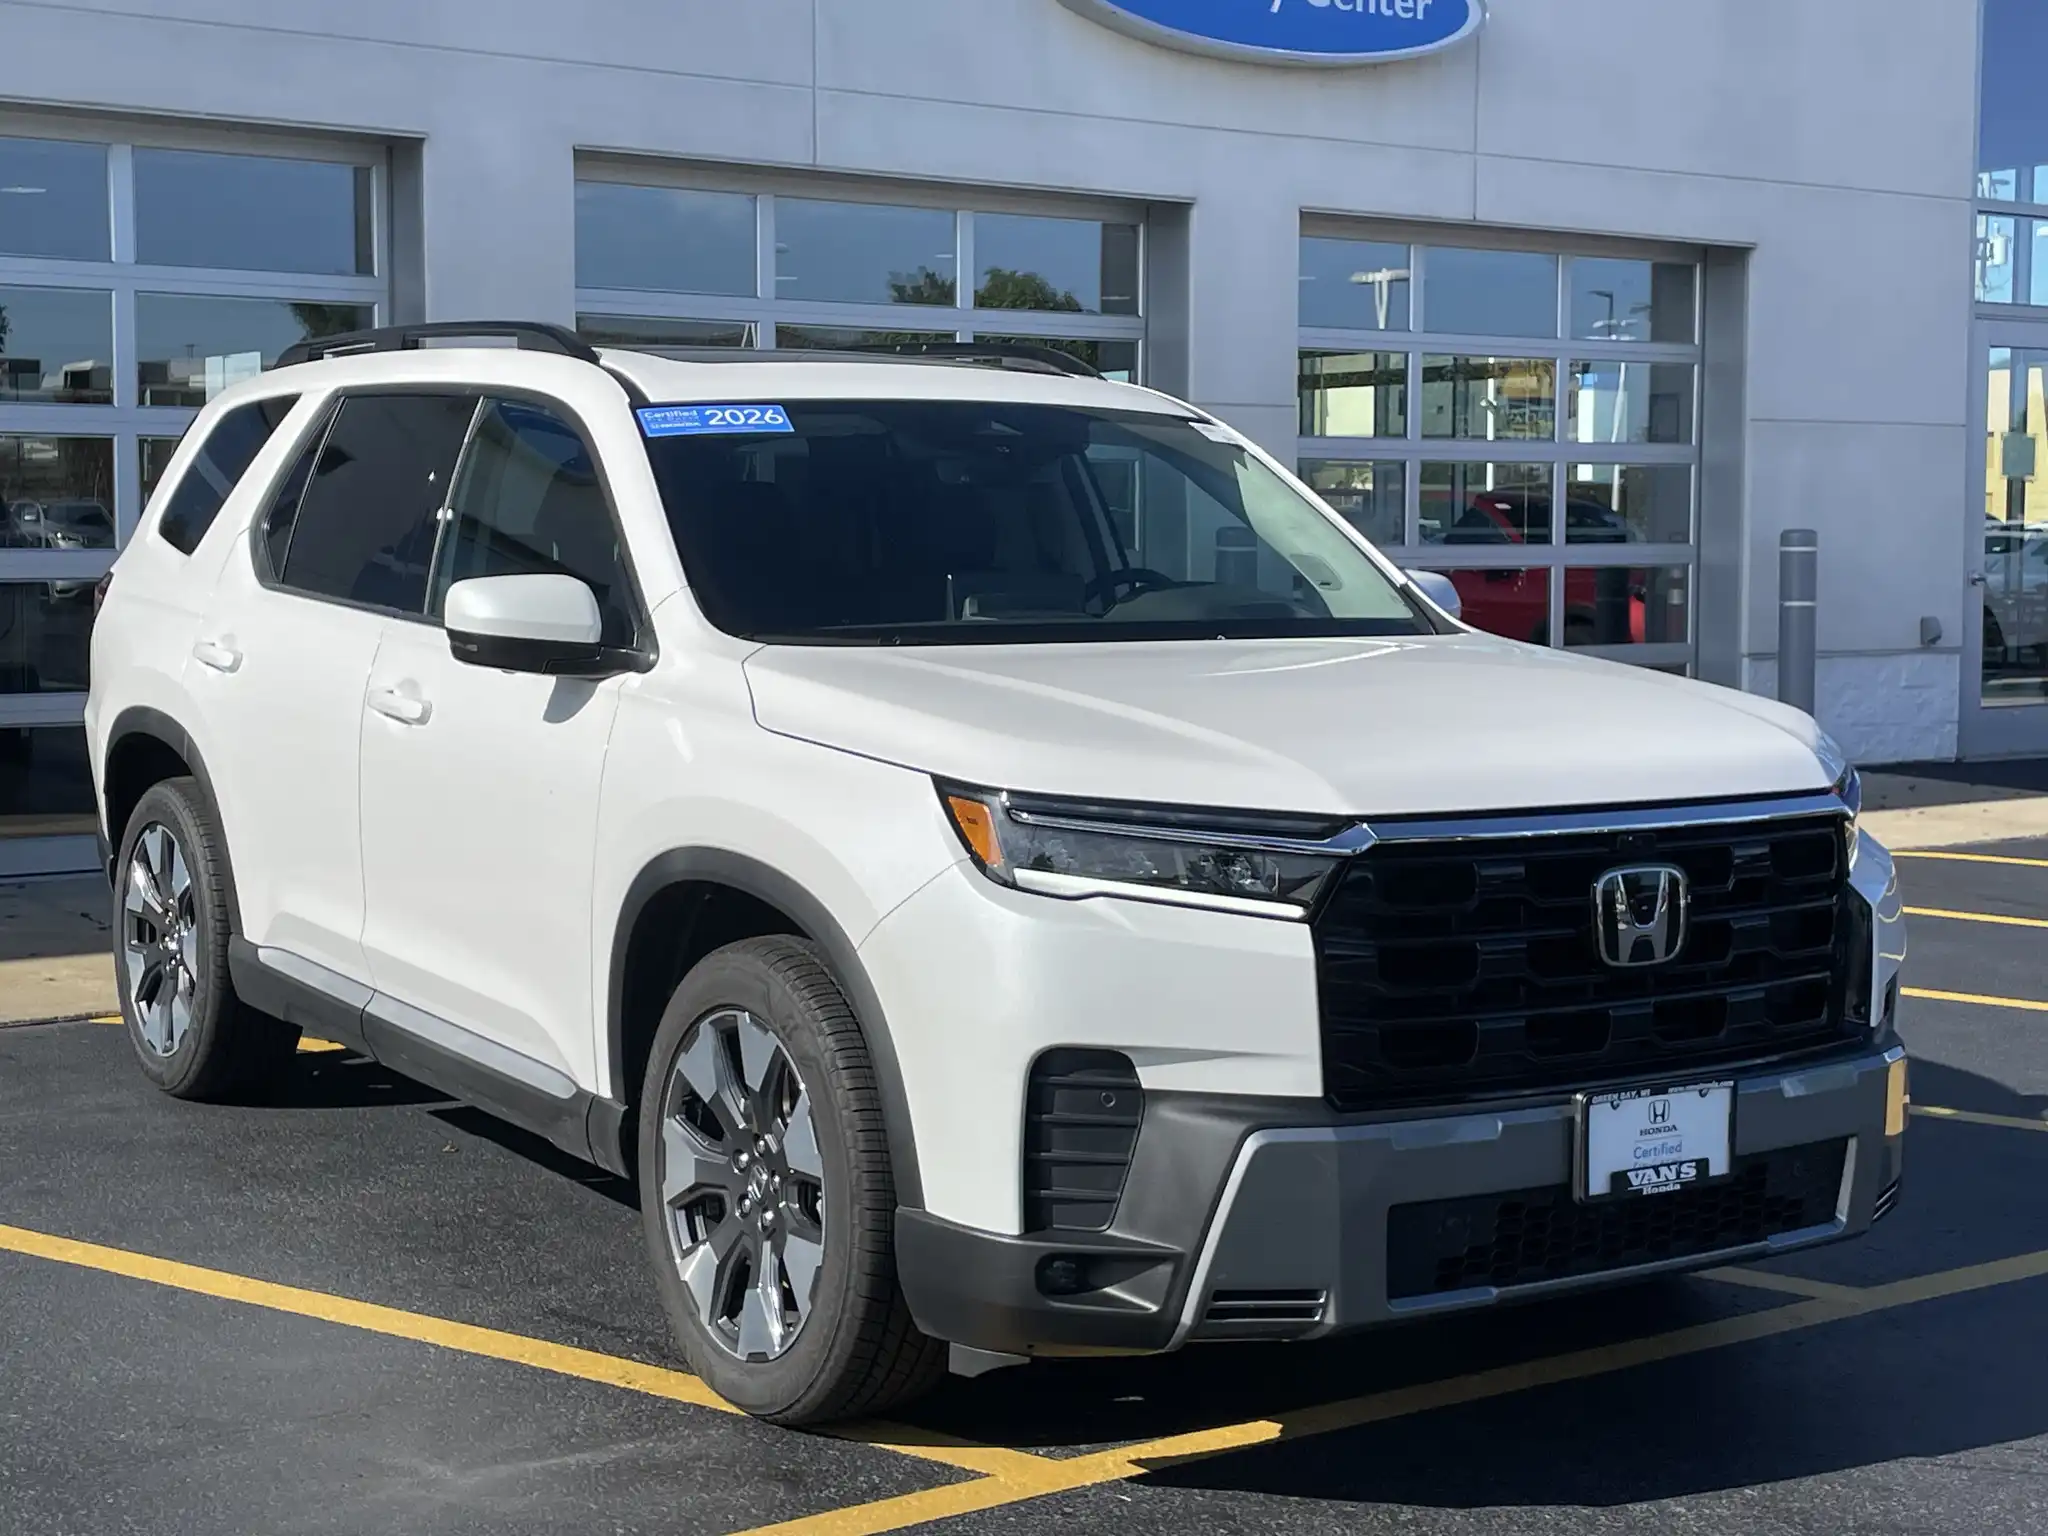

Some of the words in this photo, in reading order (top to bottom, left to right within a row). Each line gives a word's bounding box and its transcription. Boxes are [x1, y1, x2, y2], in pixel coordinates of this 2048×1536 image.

[1307, 0, 1432, 20] nter
[645, 410, 698, 419] Certified
[704, 408, 784, 425] 2026
[1639, 1124, 1678, 1137] HONDA
[1633, 1140, 1682, 1160] Certified
[1642, 1182, 1681, 1195] Honda
